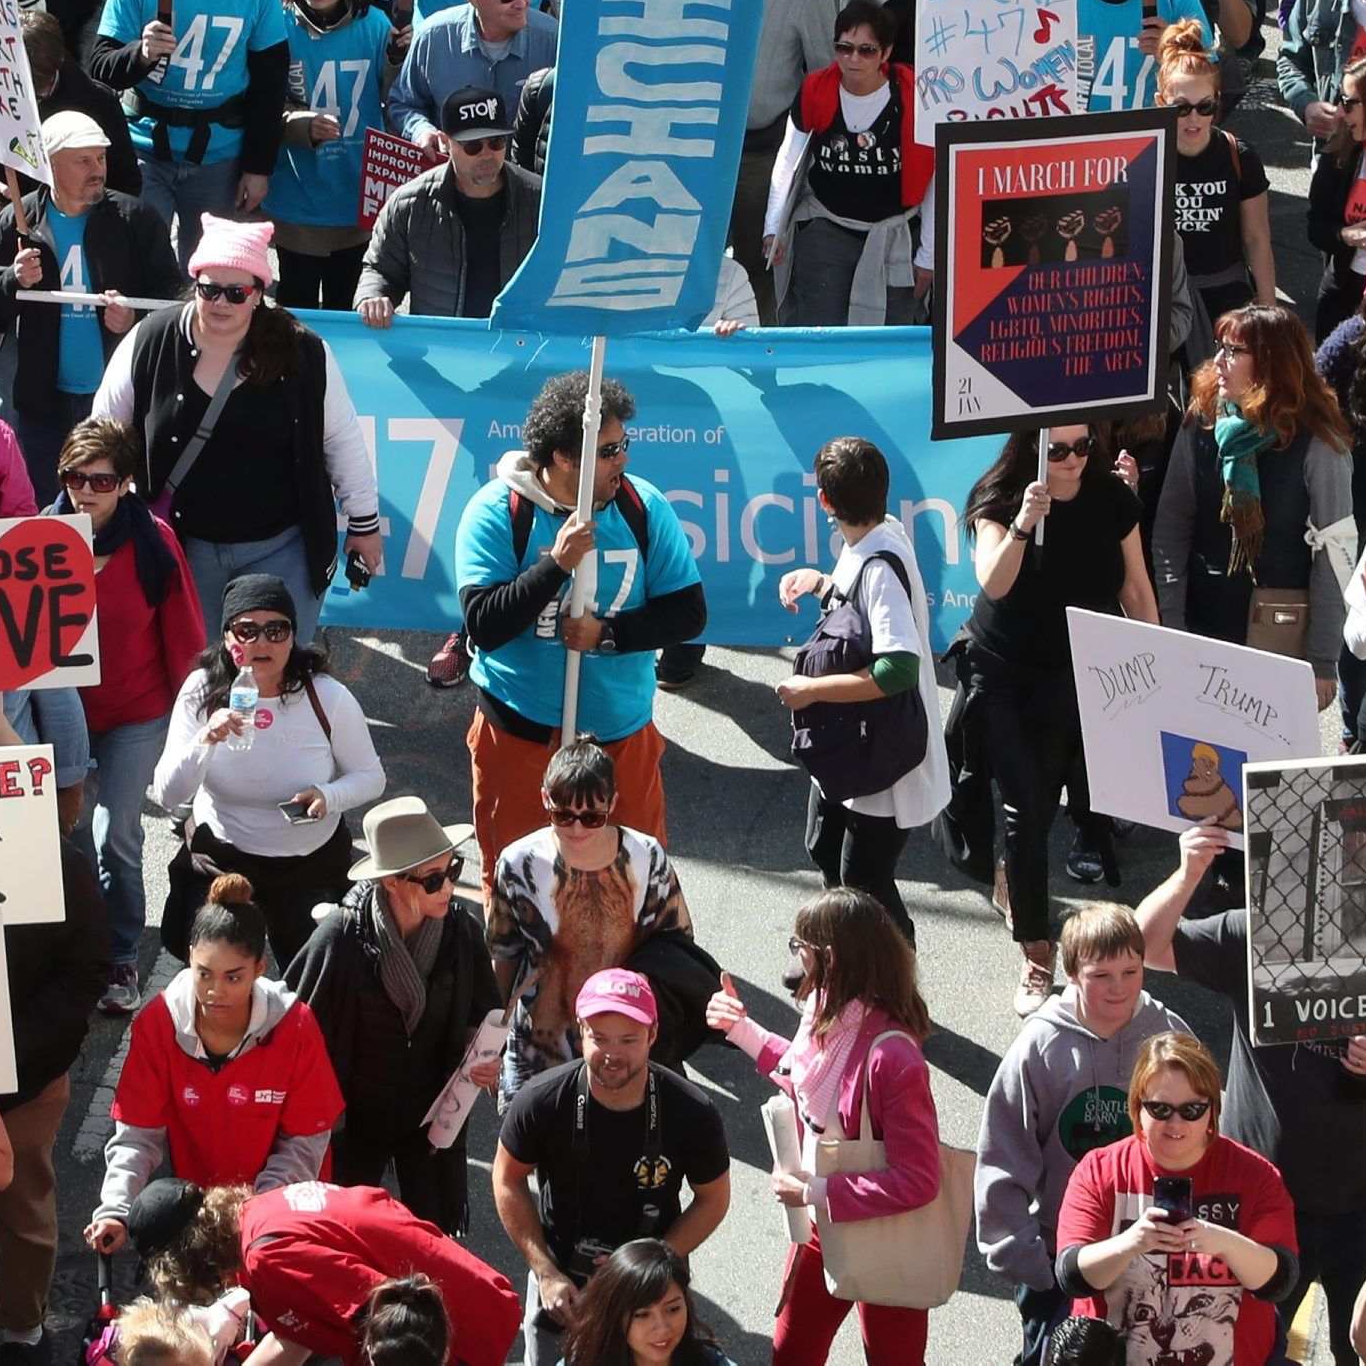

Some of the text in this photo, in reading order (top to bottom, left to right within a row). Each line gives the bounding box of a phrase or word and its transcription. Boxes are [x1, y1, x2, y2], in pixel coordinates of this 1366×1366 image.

[916, 40, 1076, 111] PRO WOMEN
[369, 135, 423, 161] PROTECT
[821, 145, 900, 161] nasty
[820, 160, 901, 175] woman
[977, 156, 1129, 195] I MARCH FOR
[1007, 289, 1080, 315] WOMEN'S
[957, 396, 982, 416] JAN
[1087, 652, 1158, 711] DUMP
[1261, 1001, 1275, 1028] 1
[1084, 1111, 1119, 1125] BARN
